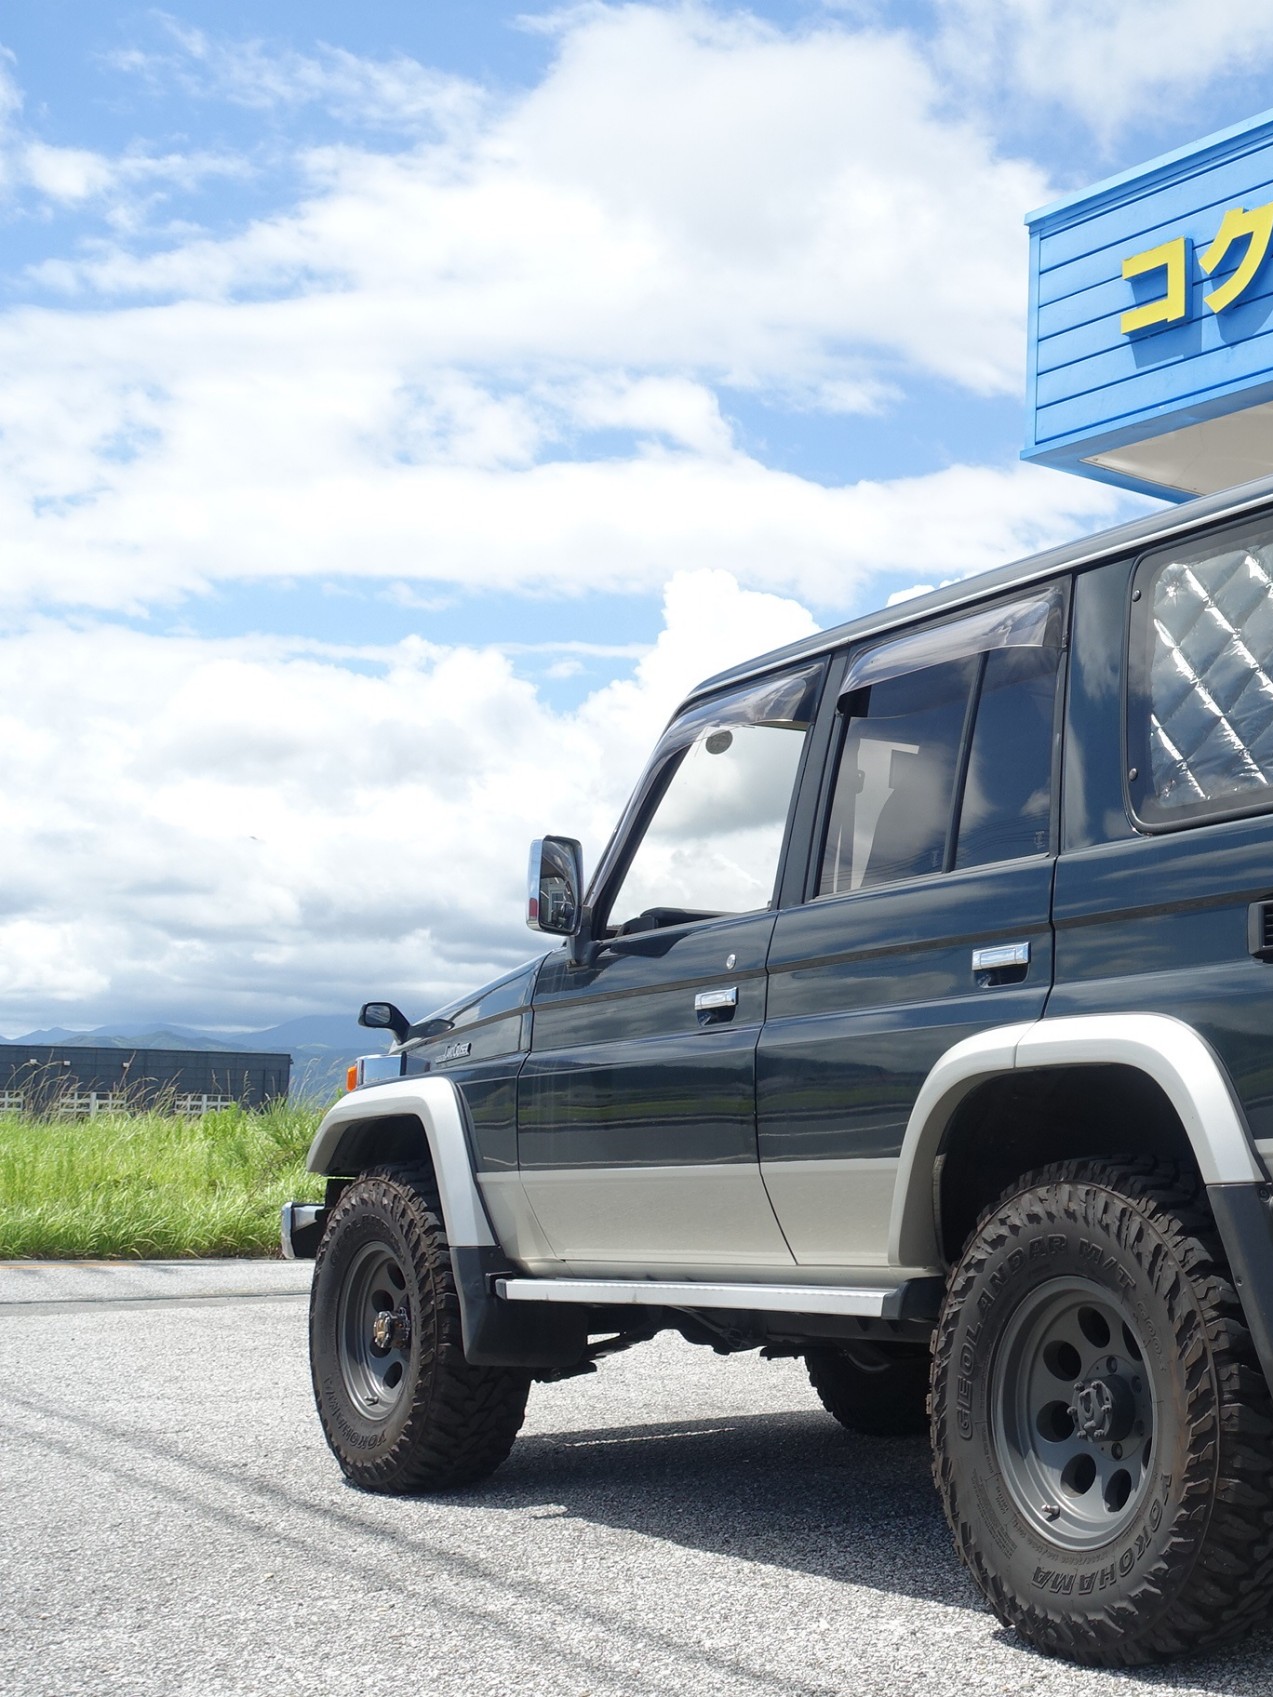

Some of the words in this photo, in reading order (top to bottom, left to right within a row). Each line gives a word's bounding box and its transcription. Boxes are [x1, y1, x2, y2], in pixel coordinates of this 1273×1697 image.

[956, 1233, 1068, 1440] GEOLANDAR
[1079, 1237, 1137, 1289] M/T
[1031, 1472, 1173, 1595] YOKOHAMA
